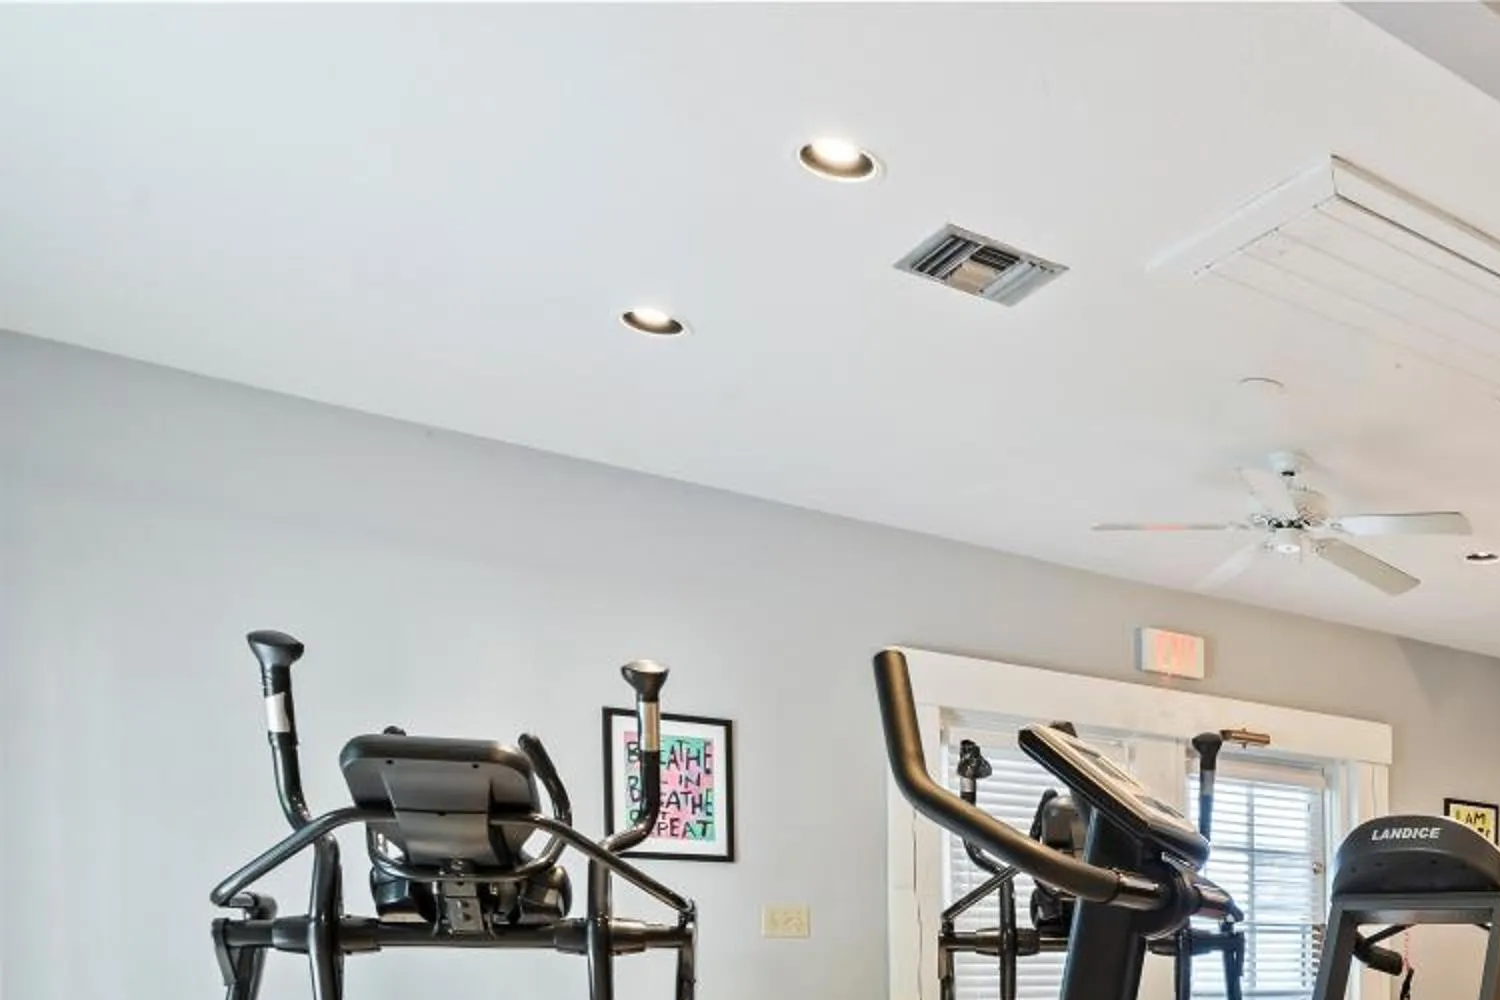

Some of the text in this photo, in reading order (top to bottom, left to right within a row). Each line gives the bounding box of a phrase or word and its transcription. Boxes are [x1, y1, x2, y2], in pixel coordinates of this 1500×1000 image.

[627, 739, 714, 775] BEATHE
[679, 773, 701, 789] IN
[627, 776, 713, 817] BEATHE
[1371, 827, 1442, 841] LANDICE
